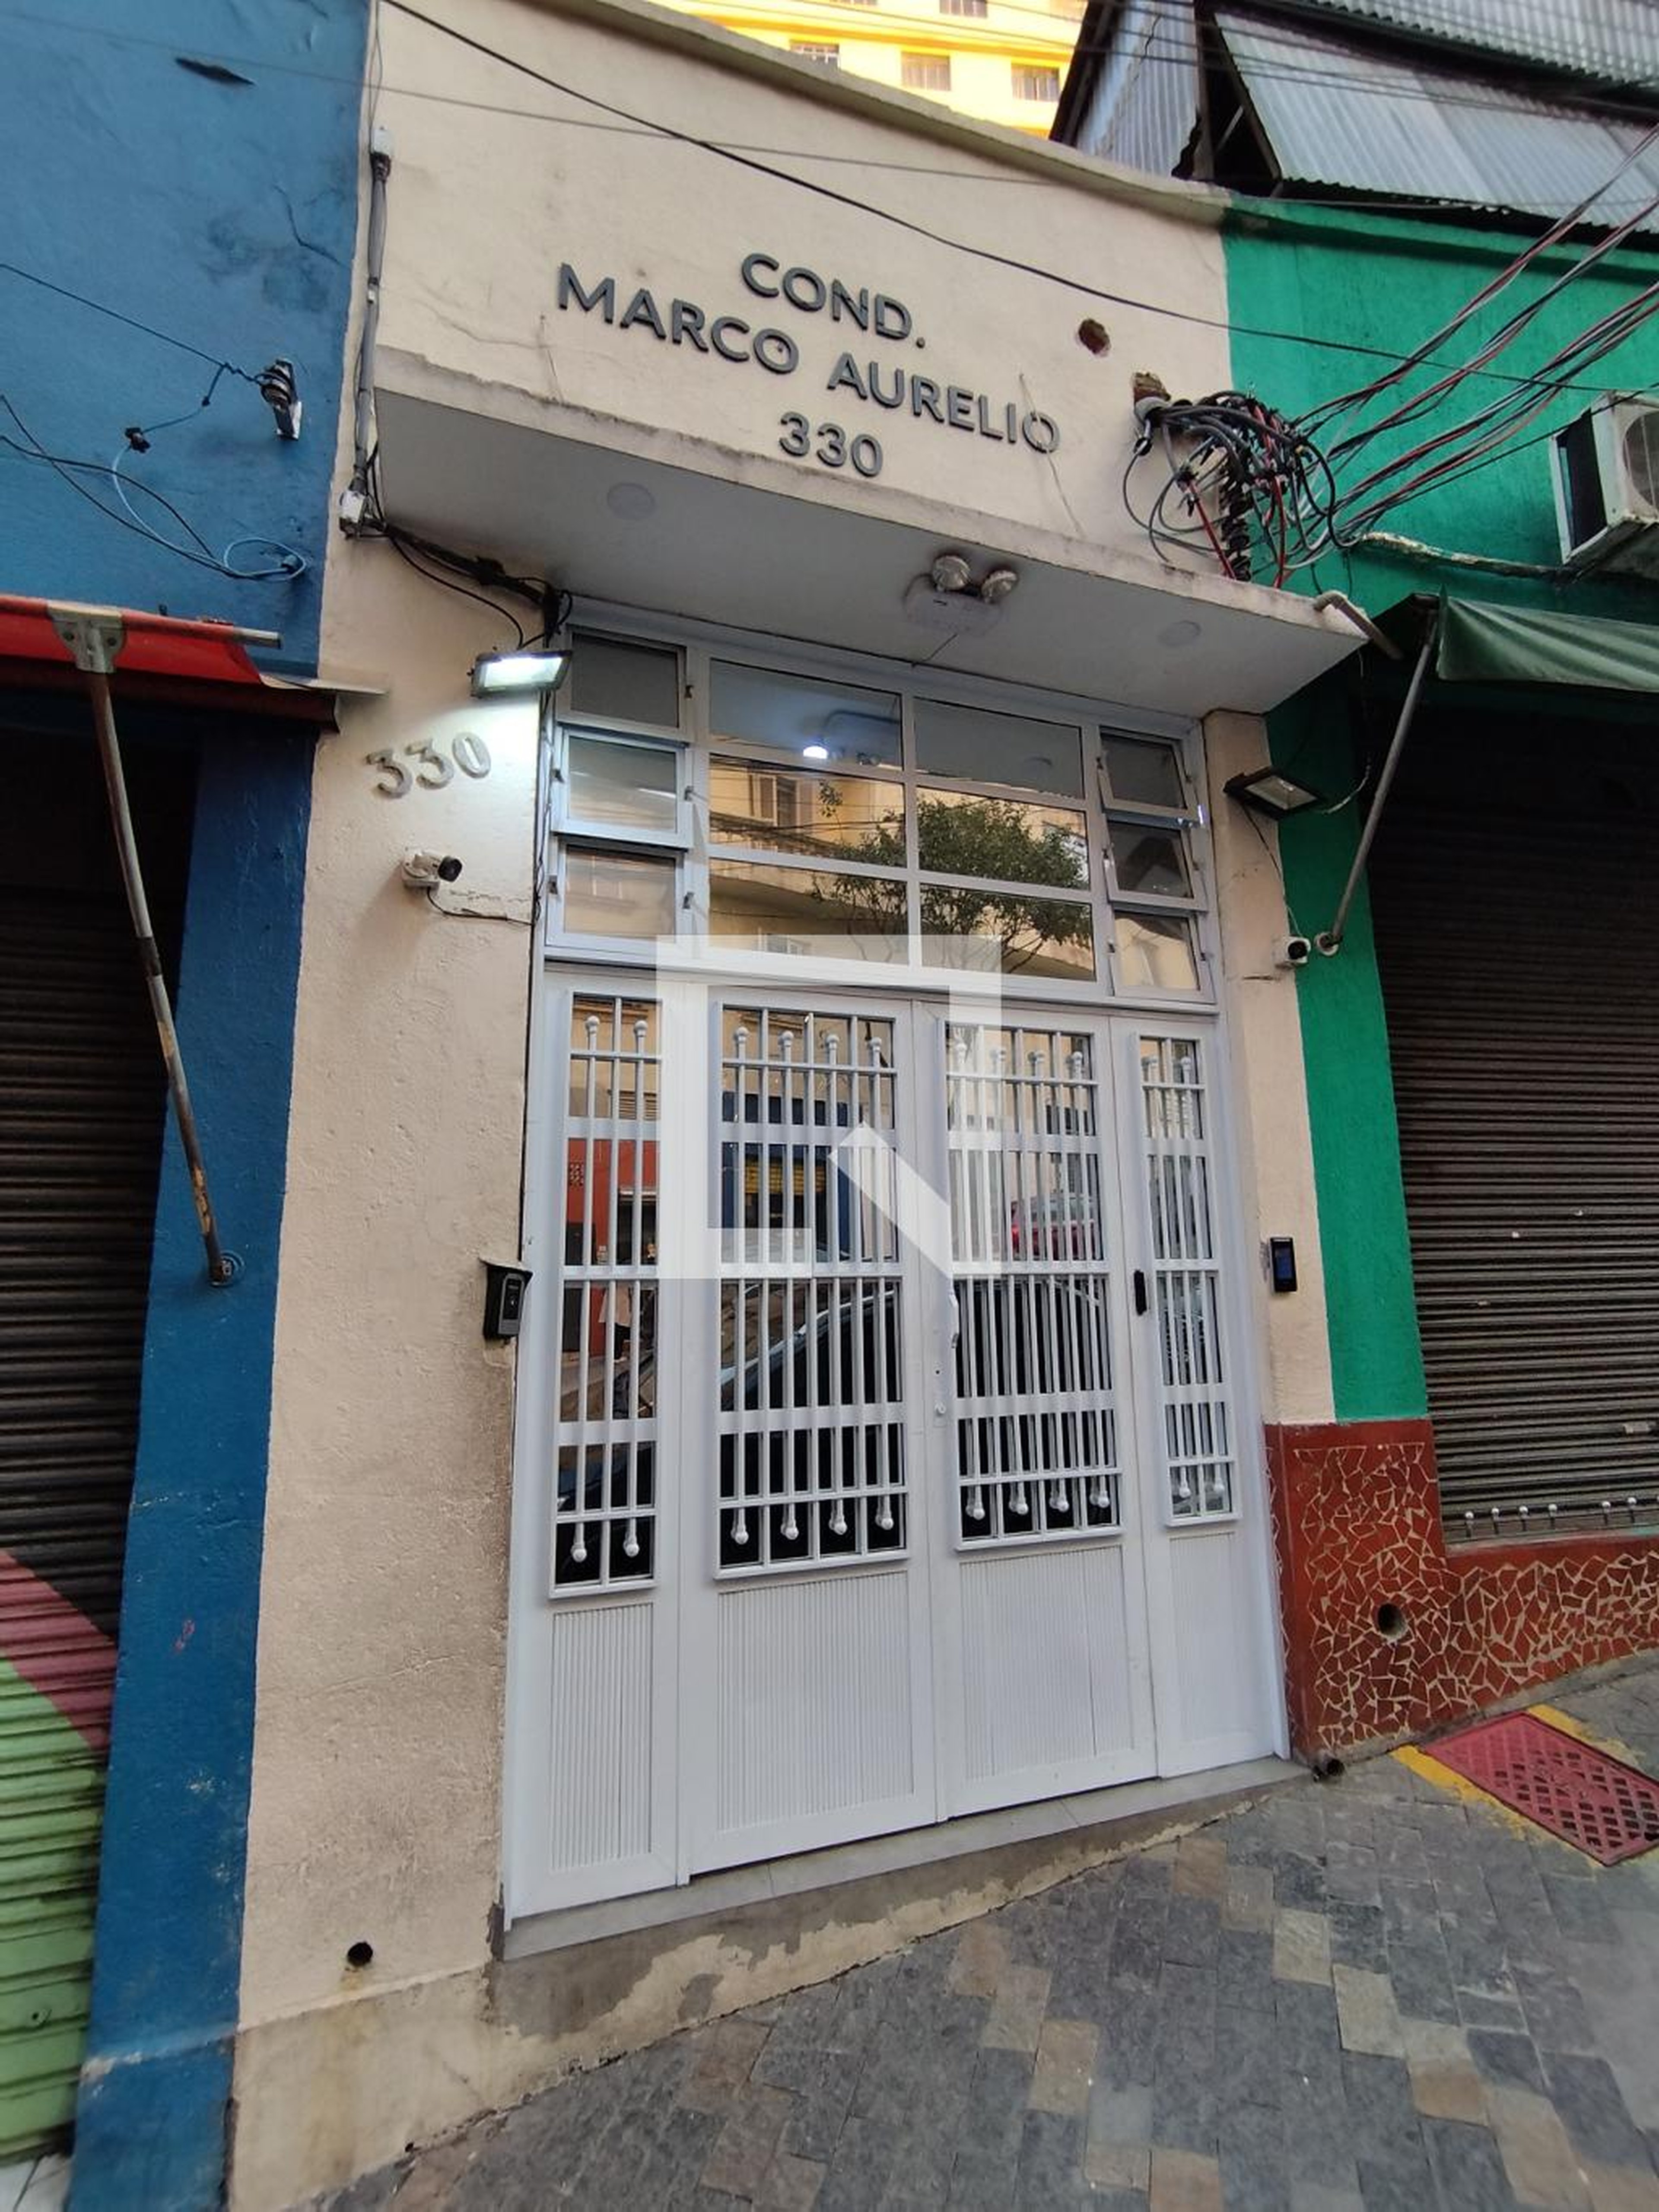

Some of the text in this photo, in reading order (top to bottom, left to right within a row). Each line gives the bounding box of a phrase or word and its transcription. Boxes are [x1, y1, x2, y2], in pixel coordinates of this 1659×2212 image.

[741, 253, 926, 348] COND.
[558, 262, 1061, 453] MARCO AURELIO
[778, 411, 884, 477] 330
[365, 732, 492, 799] 330
